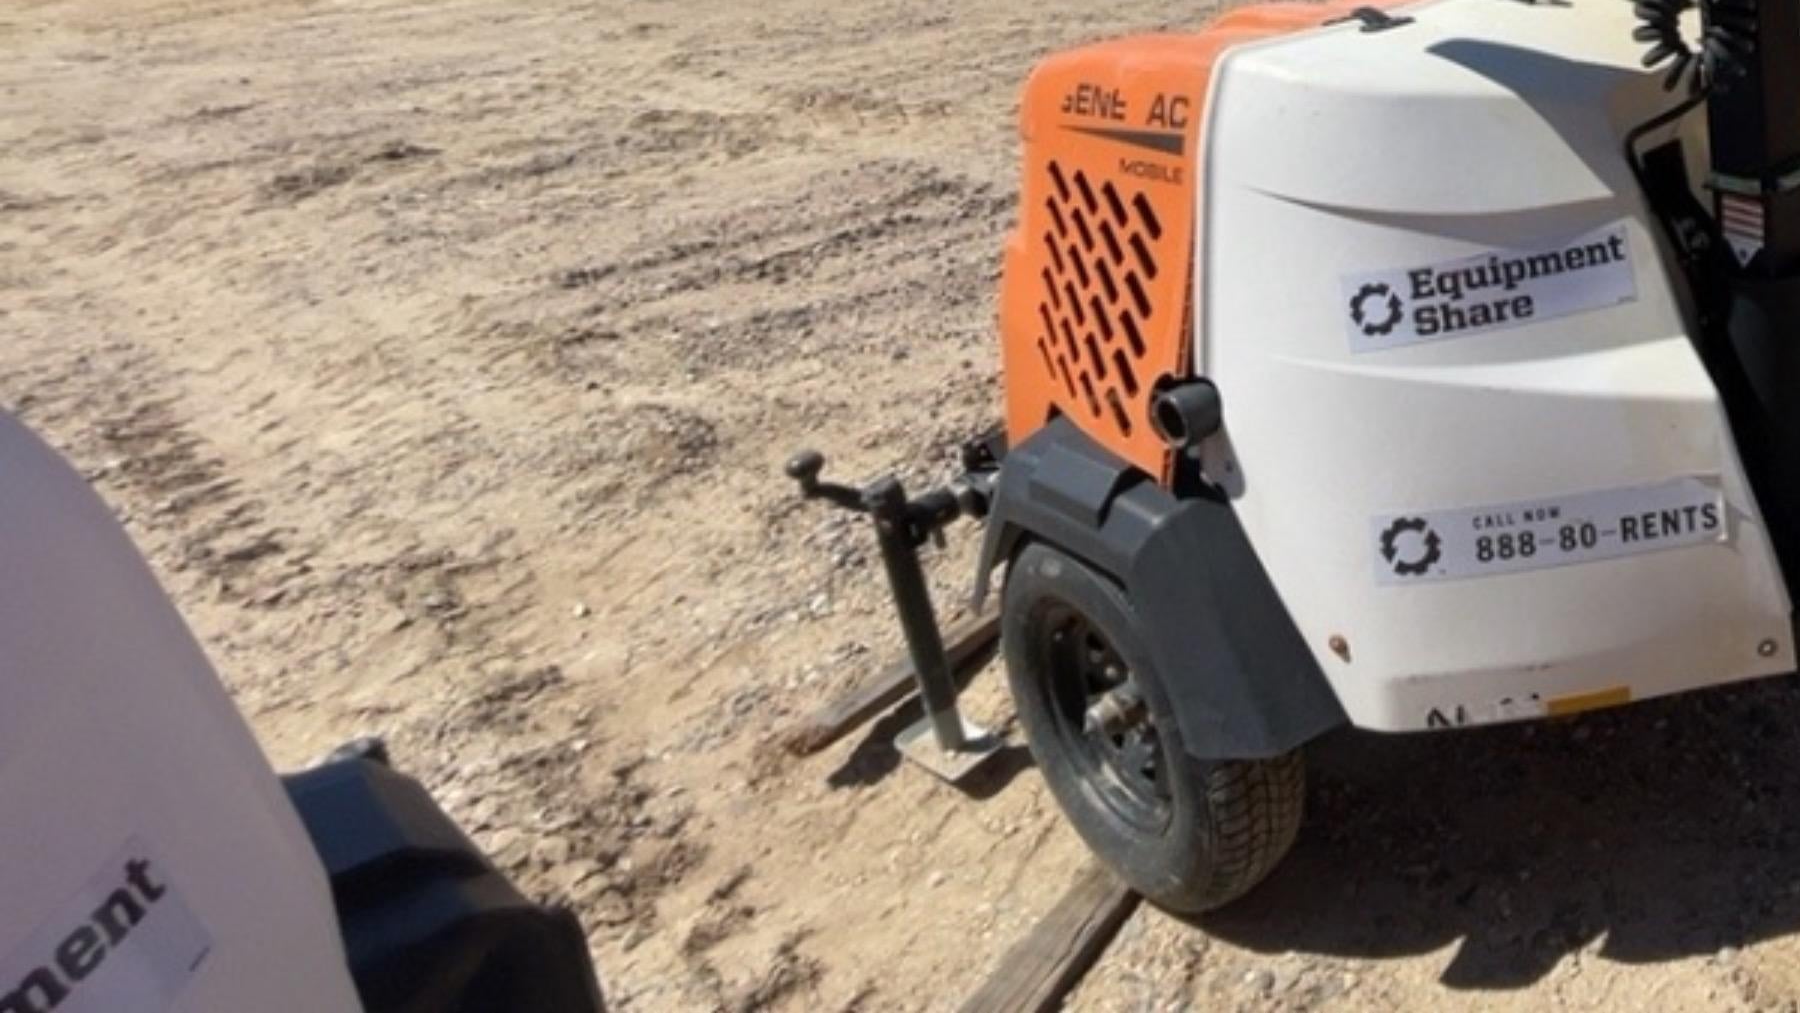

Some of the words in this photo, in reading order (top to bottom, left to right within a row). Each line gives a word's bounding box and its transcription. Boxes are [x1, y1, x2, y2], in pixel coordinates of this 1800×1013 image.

[1060, 82, 1190, 128] ENEAC
[1407, 234, 1626, 301] Equipment
[1412, 293, 1535, 336] Share
[1472, 512, 1516, 530] CALL
[1522, 505, 1561, 523] NOW
[1475, 502, 1720, 563] 888-80-RENTS
